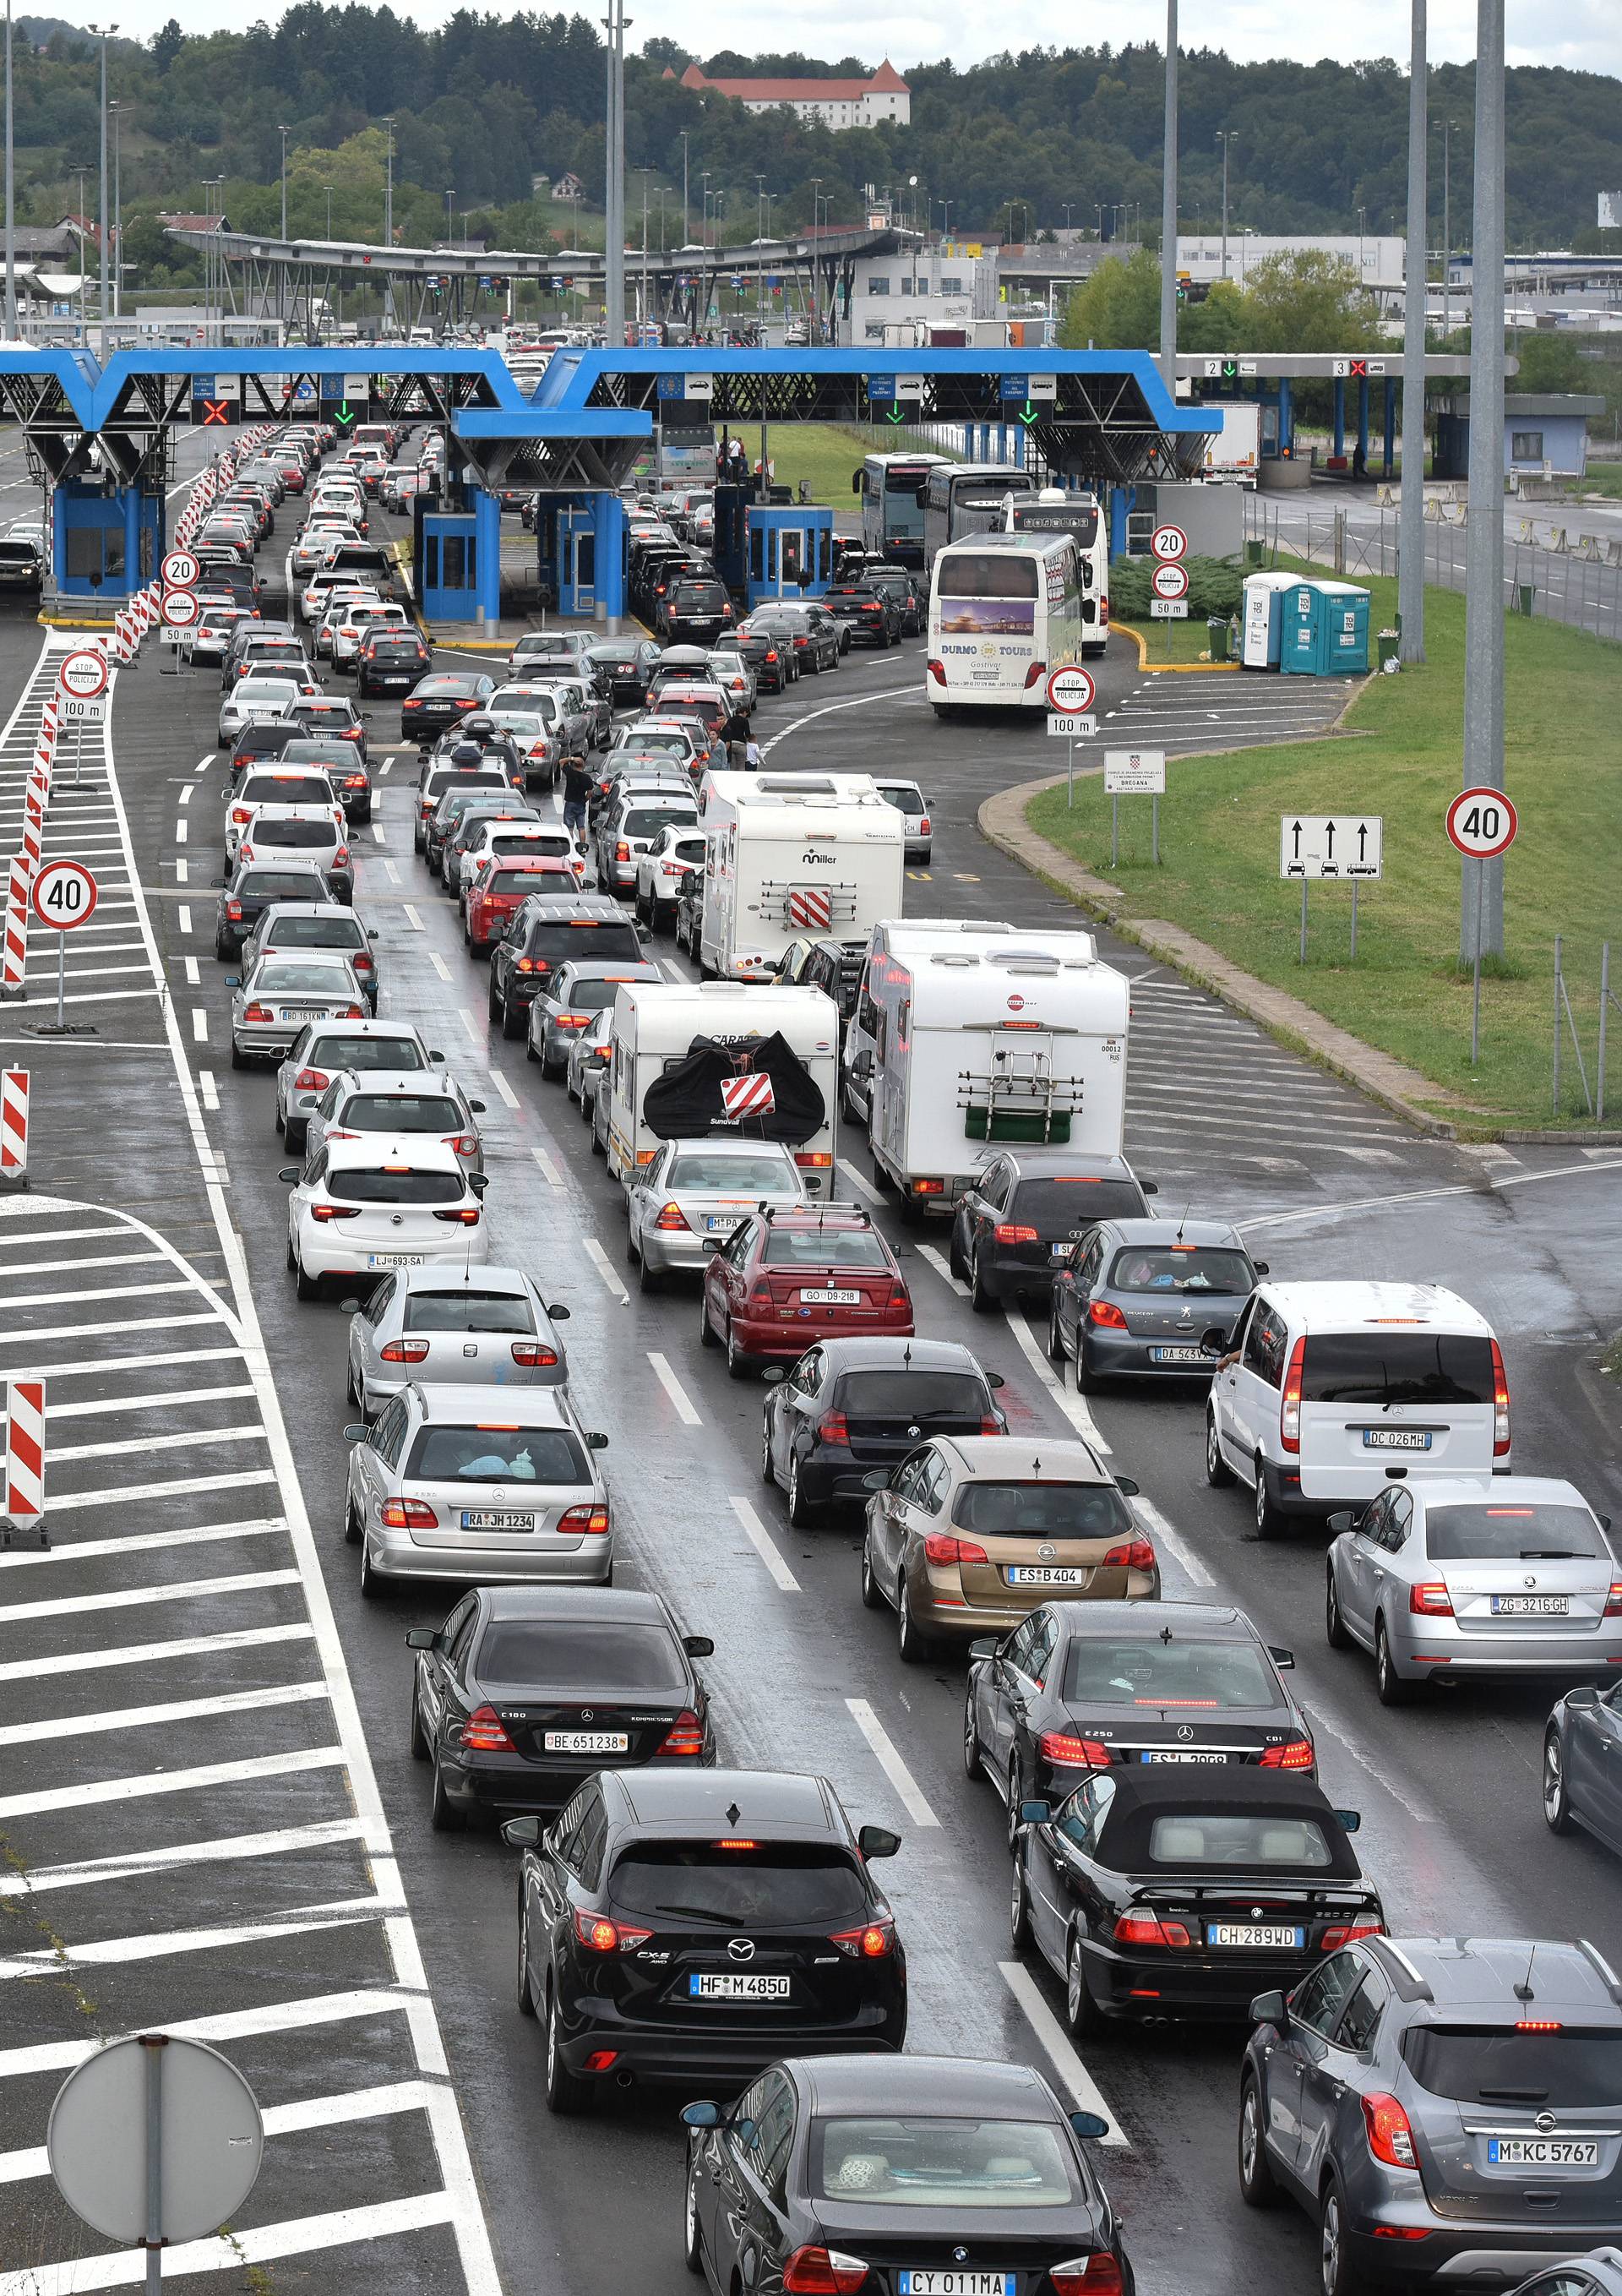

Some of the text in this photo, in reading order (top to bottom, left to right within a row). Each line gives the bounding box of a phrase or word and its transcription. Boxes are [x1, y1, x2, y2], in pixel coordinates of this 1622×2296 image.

[1210, 363, 1216, 374] 2
[1337, 363, 1344, 374] 3
[1161, 535, 1178, 551] 20
[171, 561, 190, 578] 20
[1157, 603, 1169, 613] 50
[168, 630, 179, 640] 50
[941, 645, 977, 655] DURMO
[999, 646, 1032, 656] TOURS
[69, 675, 98, 684] POLICIJA
[65, 702, 100, 717] 100 m
[1053, 719, 1090, 732] 100 m
[1462, 807, 1500, 839] 40
[47, 880, 81, 911] 40
[714, 1219, 720, 1227] M
[726, 1219, 738, 1227] PA
[377, 1257, 420, 1265] LJ 693-SA
[806, 1291, 855, 1301] GO D9-218
[1162, 1348, 1174, 1357] DA
[1371, 1432, 1423, 1446] DC 026MH
[469, 1514, 532, 1528] RA JH 1234
[1019, 1569, 1075, 1583] ES B 404
[1500, 1599, 1515, 1610] ZG
[1220, 1928, 1293, 1945] CH 289WD
[699, 1976, 787, 1994] HF M 4850
[1499, 2143, 1596, 2163] M KC 5767
[911, 2272, 1002, 2294] CY 011MA
